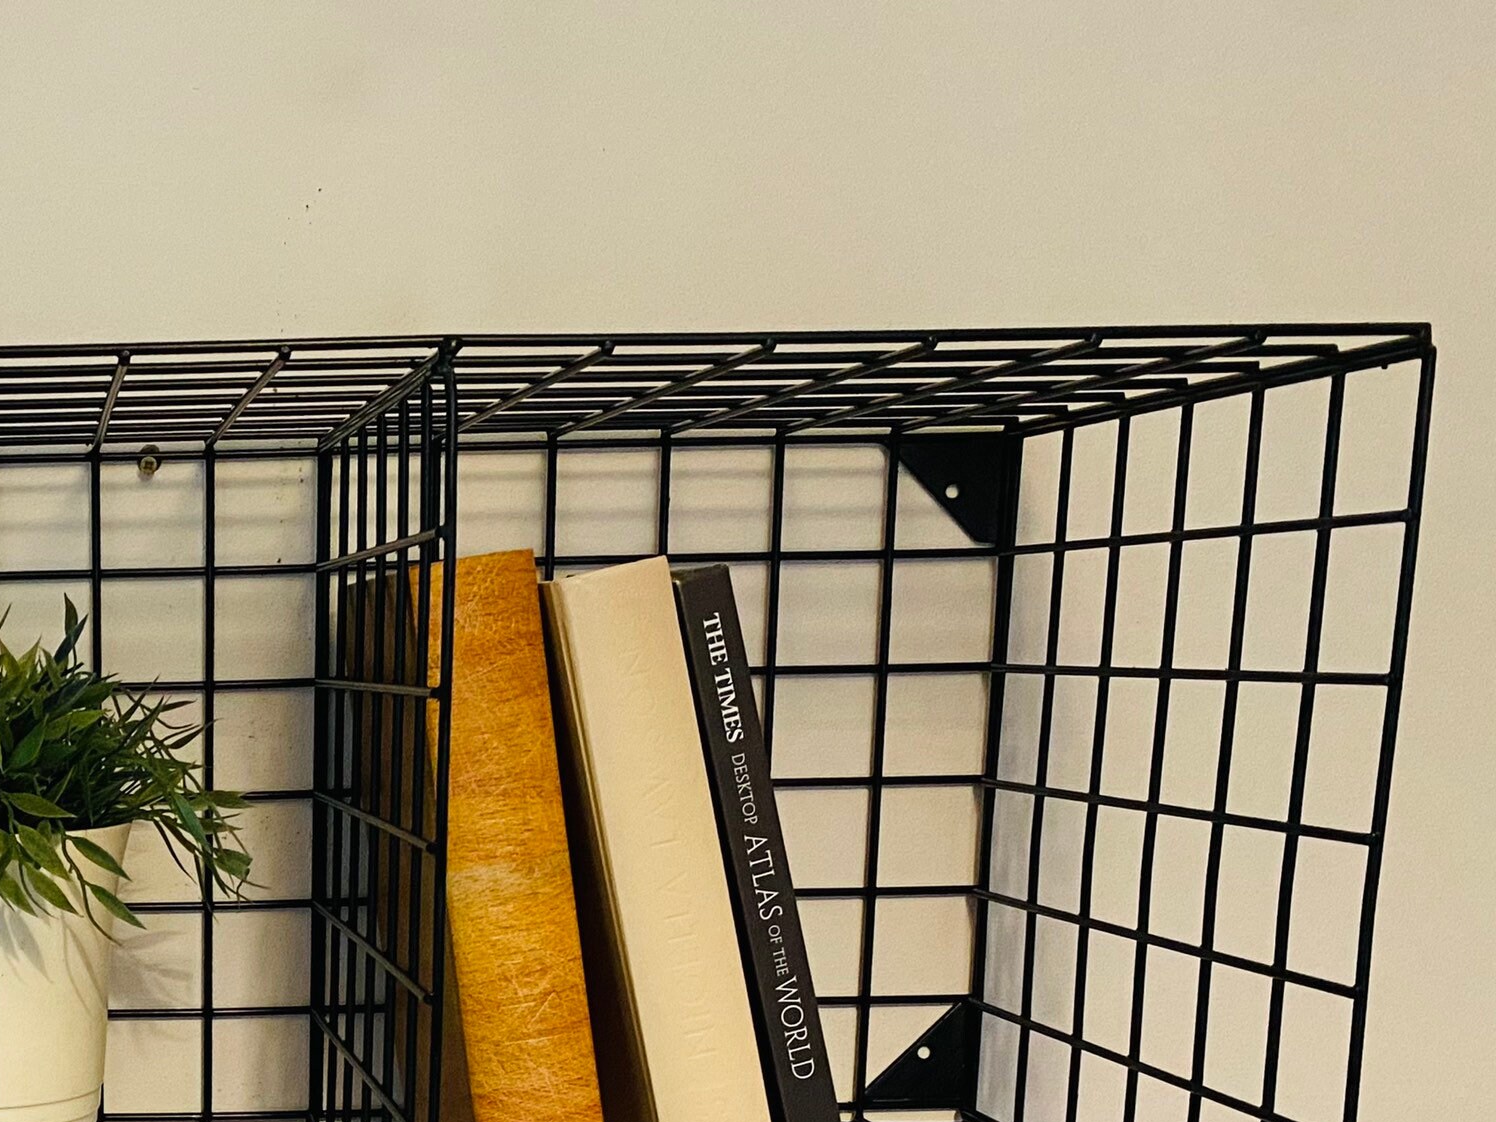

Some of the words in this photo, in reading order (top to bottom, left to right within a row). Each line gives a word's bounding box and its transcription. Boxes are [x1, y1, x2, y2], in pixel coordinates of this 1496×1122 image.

[703, 612, 728, 666] THE
[714, 667, 744, 744] TIMES
[731, 753, 758, 824] DESKTOP
[744, 834, 783, 921] ATLAS
[768, 925, 783, 944] OF
[773, 948, 789, 977] THE
[775, 975, 815, 1080] WORLD
